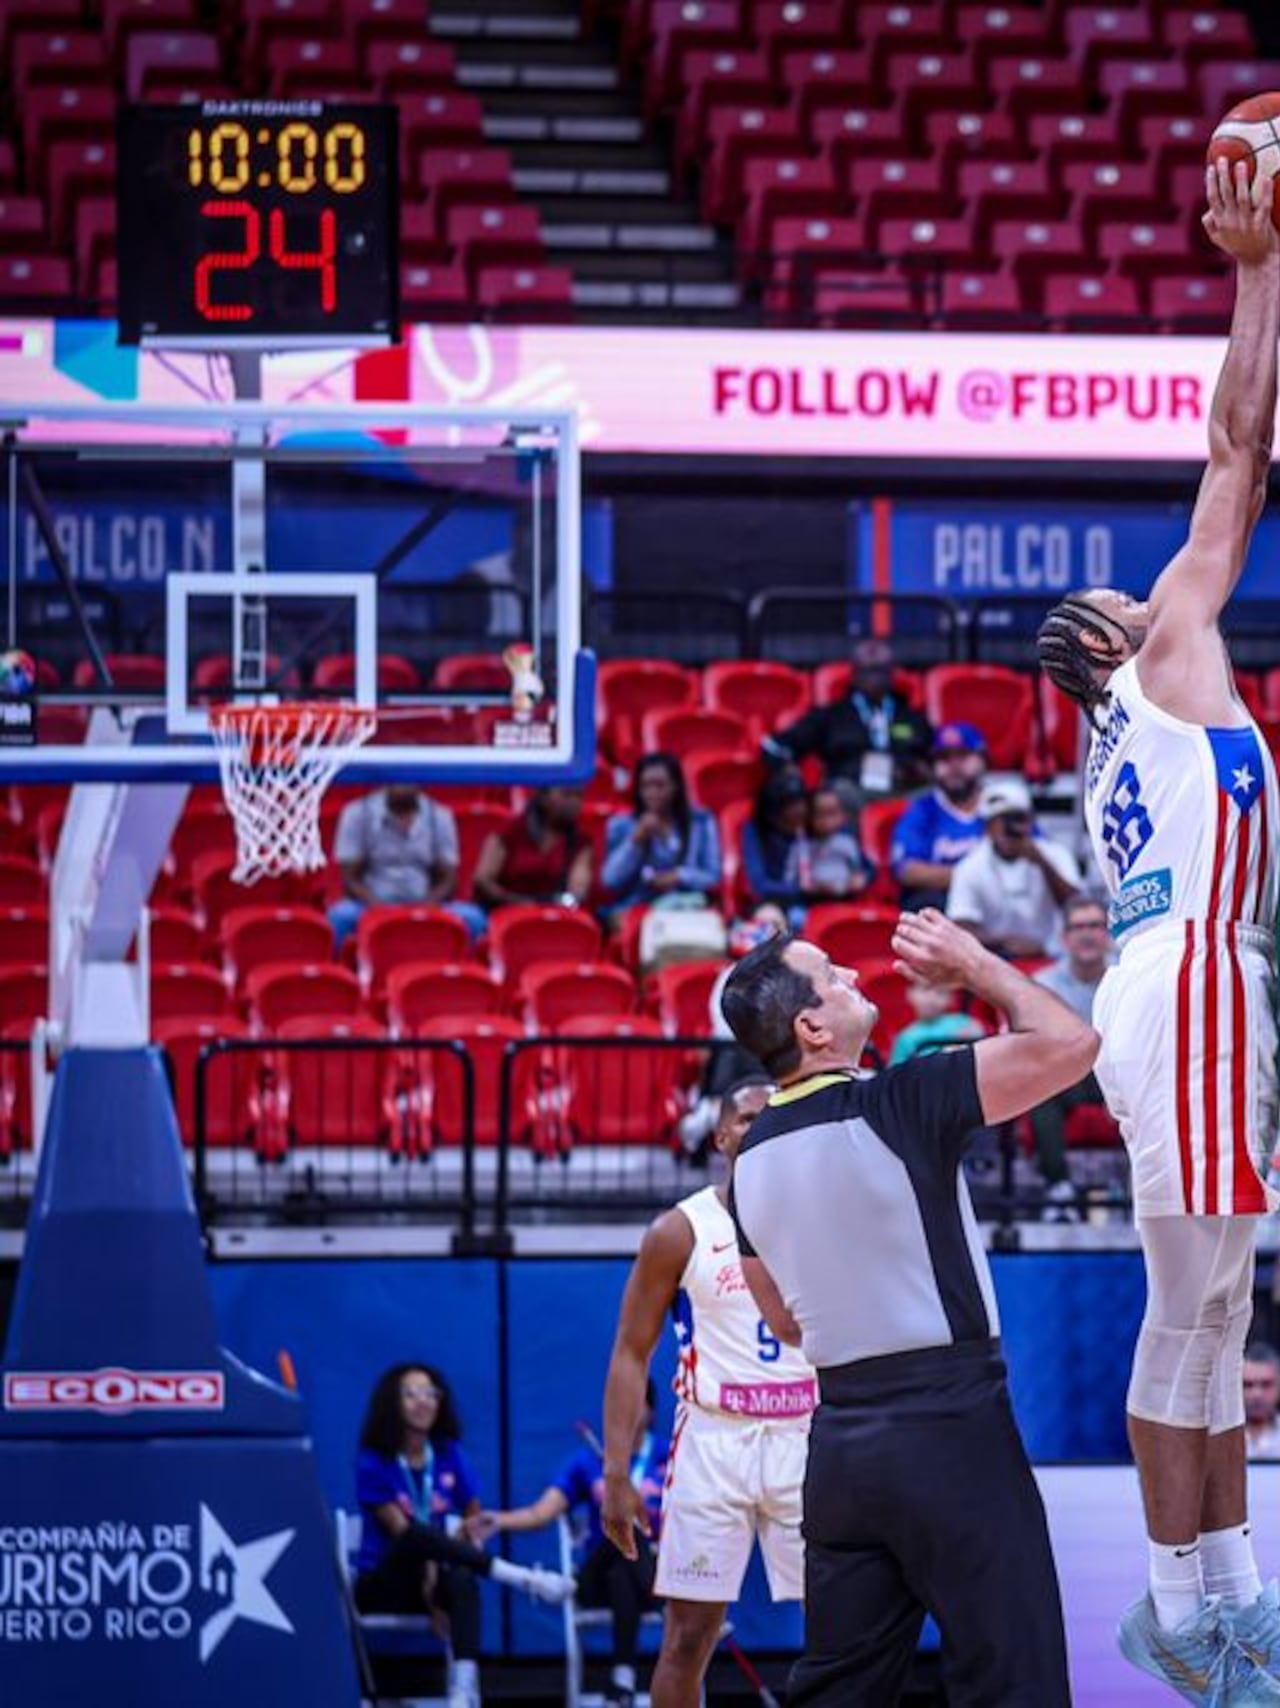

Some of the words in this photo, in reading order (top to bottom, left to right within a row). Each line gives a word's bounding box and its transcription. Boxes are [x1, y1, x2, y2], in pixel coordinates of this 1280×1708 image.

[188, 123, 365, 193] 10:00
[195, 201, 337, 321] 24
[711, 368, 939, 418] FOLLOW
[956, 370, 1203, 421] @FBPUR
[182, 515, 214, 573] N
[934, 523, 1070, 588] PALCO
[11, 1375, 217, 1404] ECONO
[750, 1387, 812, 1413] Mobile
[0, 1521, 146, 1551] COMPAÑÍA
[153, 1524, 191, 1551] DE
[0, 1608, 92, 1641] ERTO
[105, 1607, 192, 1641] RICO
